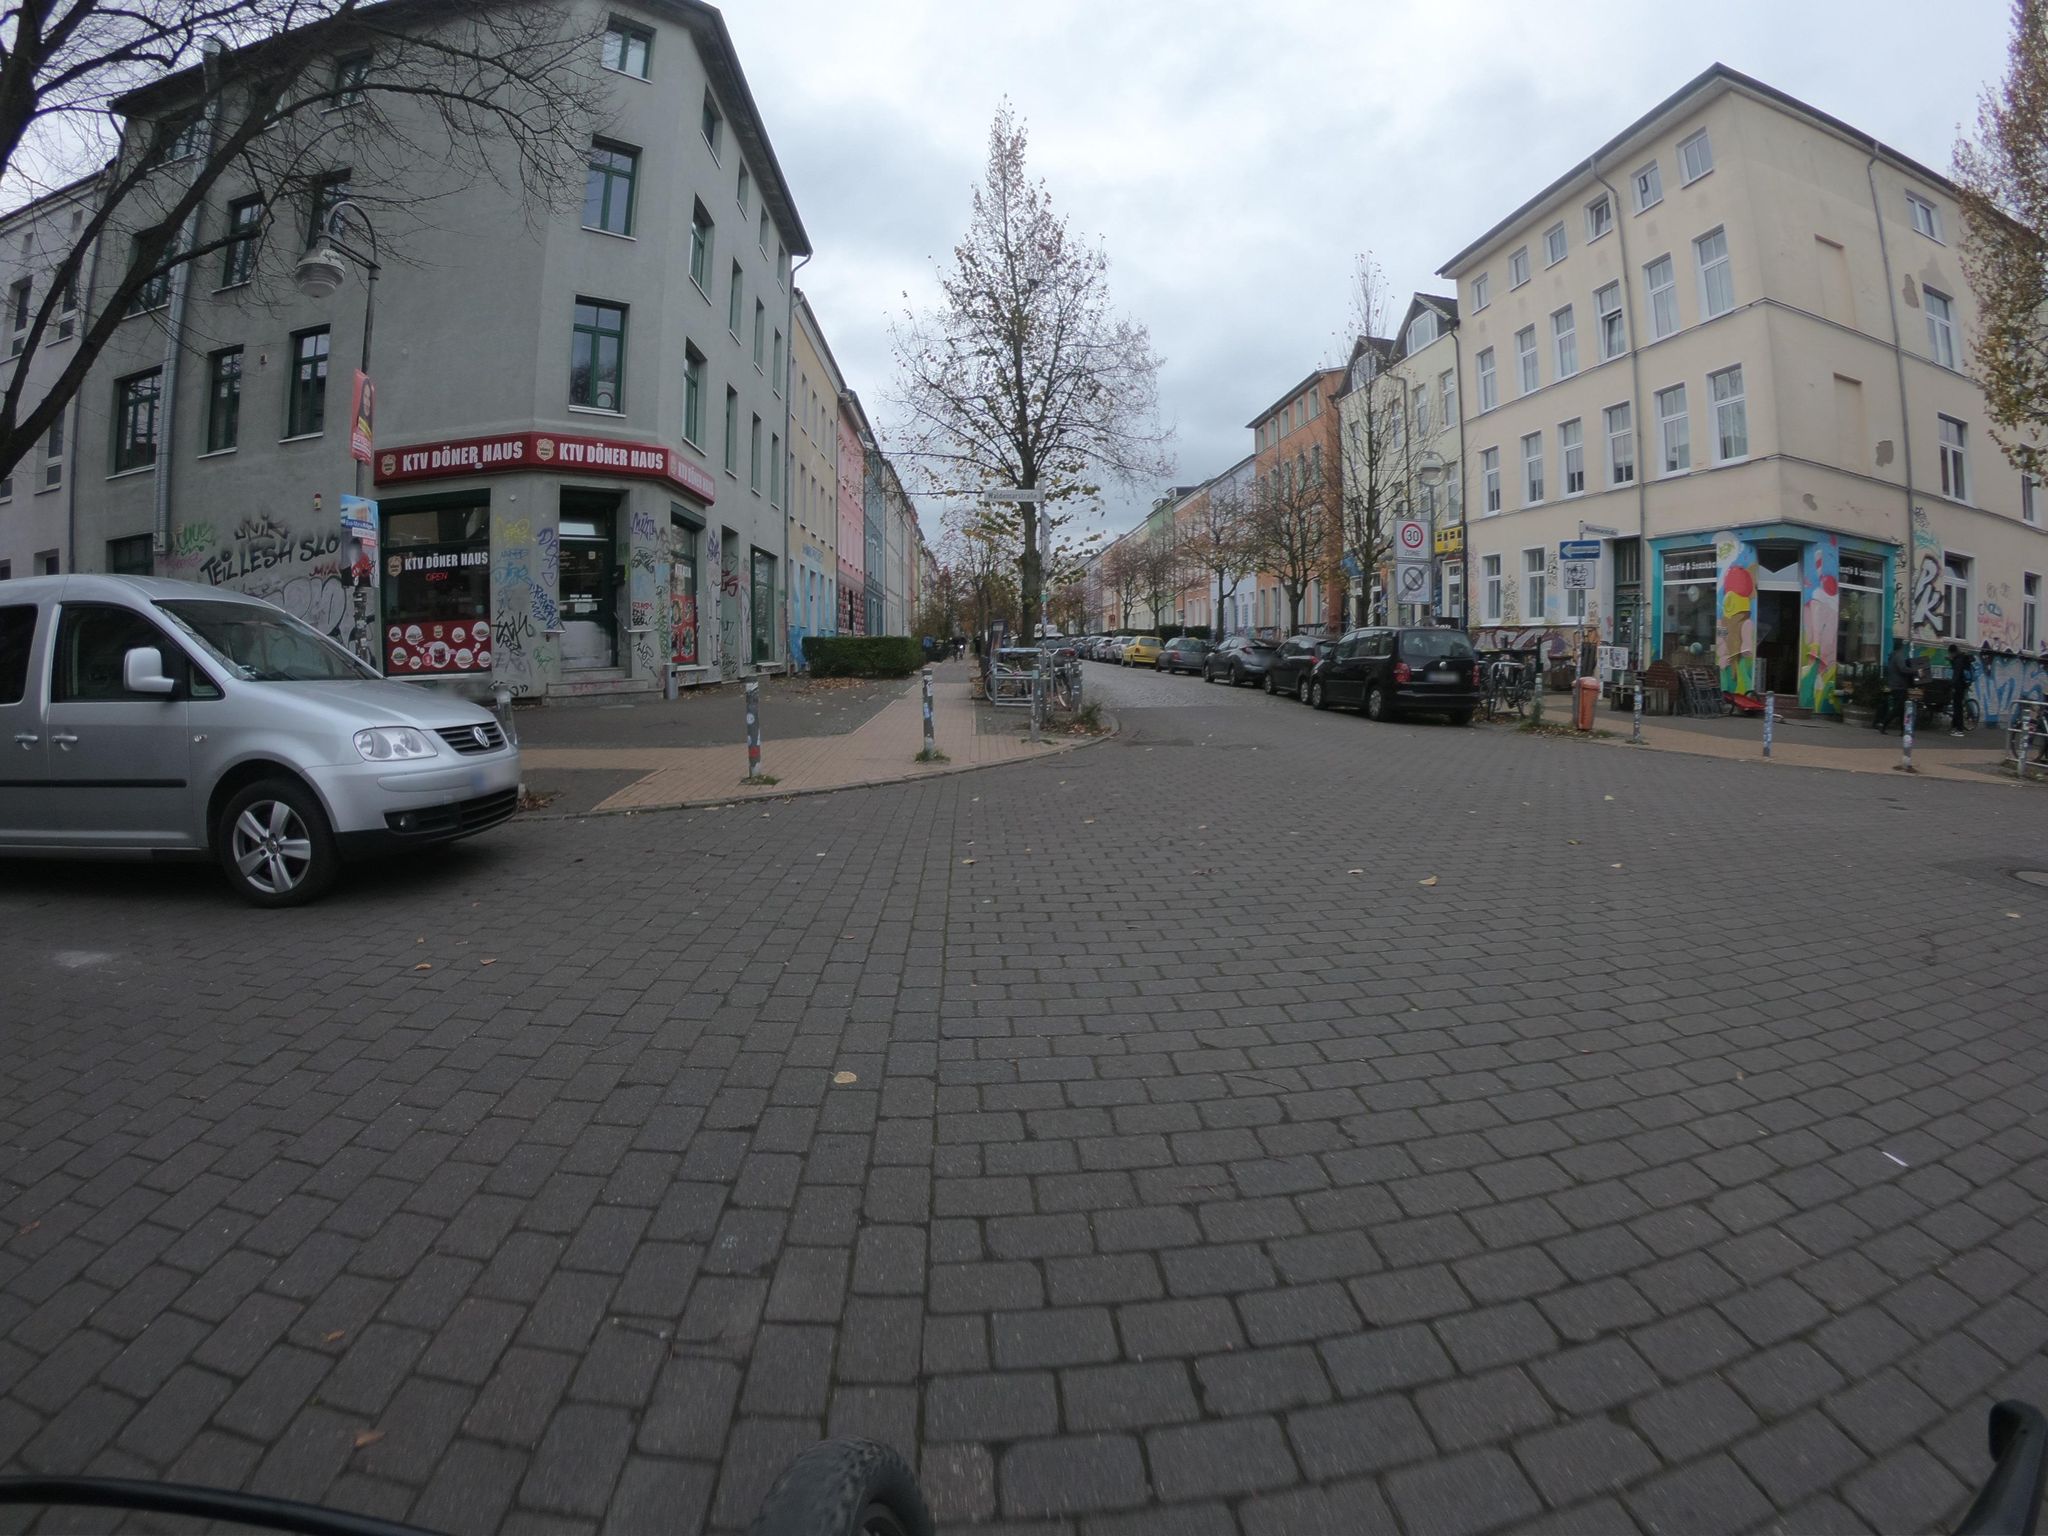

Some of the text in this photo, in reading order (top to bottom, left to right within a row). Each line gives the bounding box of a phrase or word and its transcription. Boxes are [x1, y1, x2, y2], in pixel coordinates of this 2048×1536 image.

[402, 451, 429, 472] KTV
[431, 446, 478, 468] DÖNER
[482, 441, 523, 463] HAUS
[559, 443, 584, 462] KTV
[586, 443, 628, 466] DÖNER
[630, 450, 664, 470] HAUS
[1406, 530, 1420, 542] 30
[404, 556, 424, 571] KTV
[425, 553, 458, 569] DÖNER
[460, 552, 489, 566] HAUS
